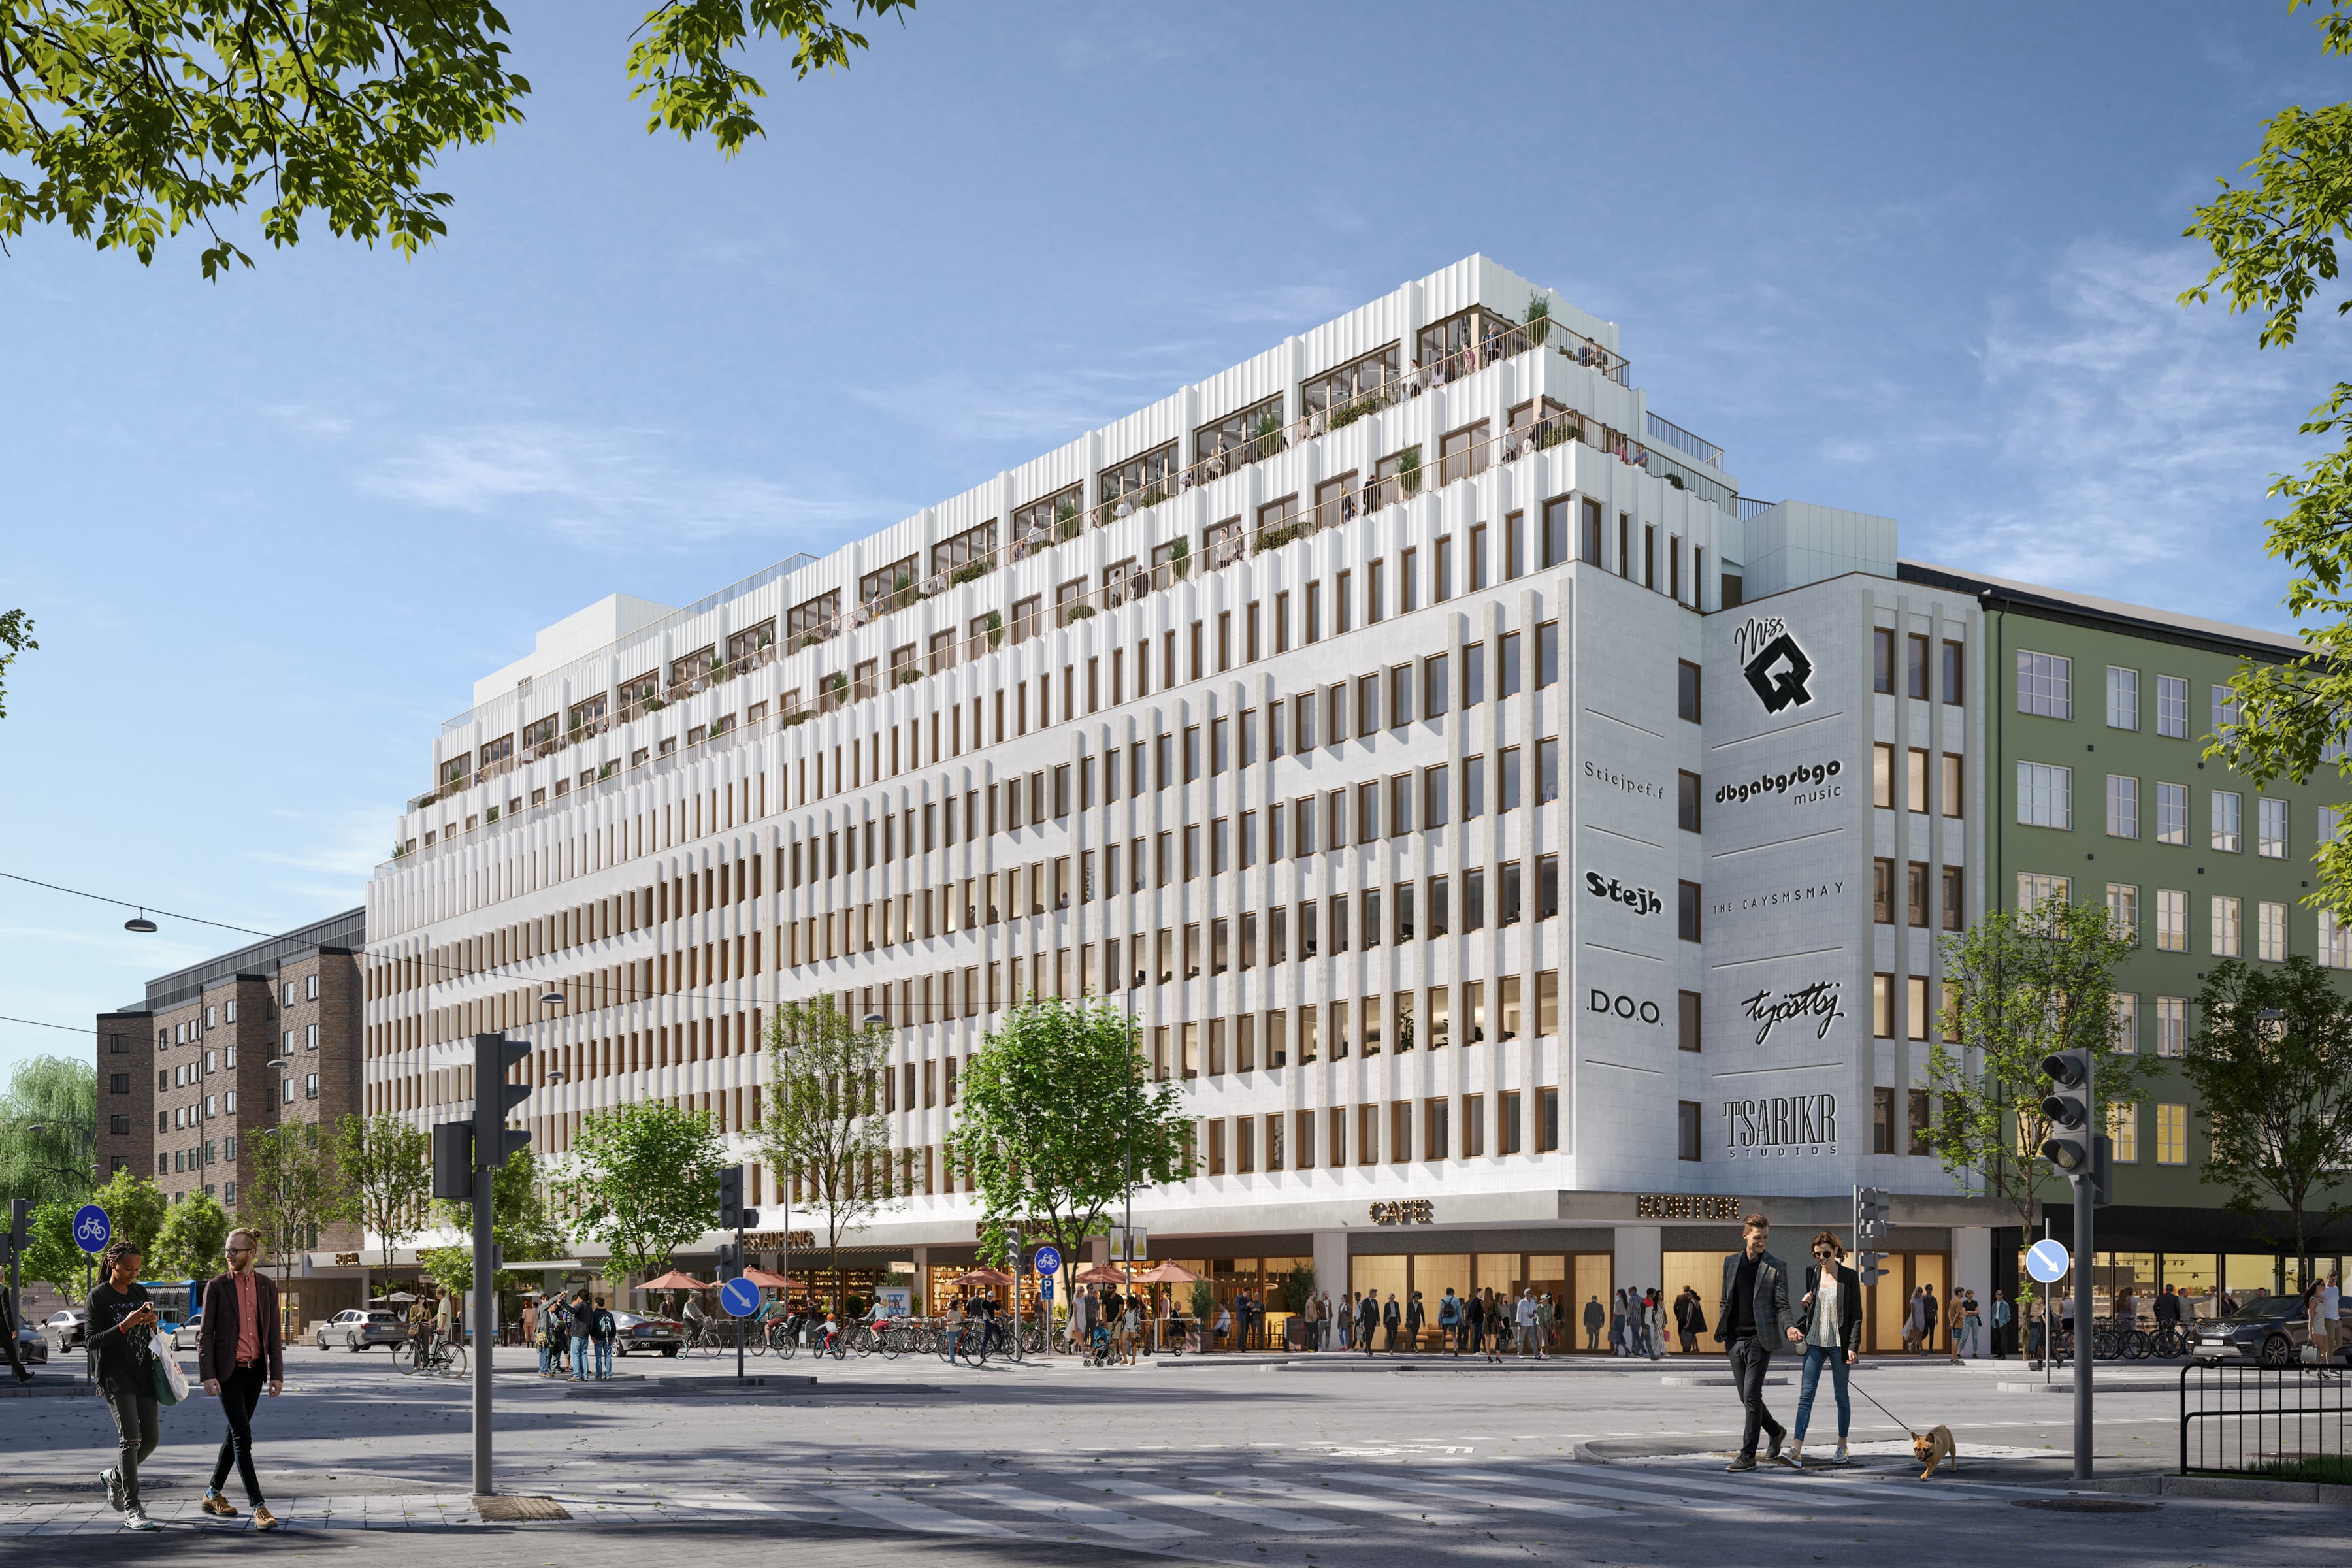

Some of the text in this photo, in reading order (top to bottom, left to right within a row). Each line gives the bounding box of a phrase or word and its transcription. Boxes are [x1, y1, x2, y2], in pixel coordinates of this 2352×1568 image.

[1735, 617, 1784, 666] Miss
[1743, 632, 1812, 715] Q
[1794, 785, 1841, 805] music
[1586, 872, 1662, 915] Stejh
[1713, 881, 1844, 914] THE CAYSMSMAY
[1722, 1094, 1837, 1147] TSARIKR
[1729, 1146, 1837, 1158] STUDIOS
[1369, 1200, 1426, 1223] CAFE
[1639, 1195, 1740, 1219] KONTOR
[1044, 1280, 1052, 1290] P
